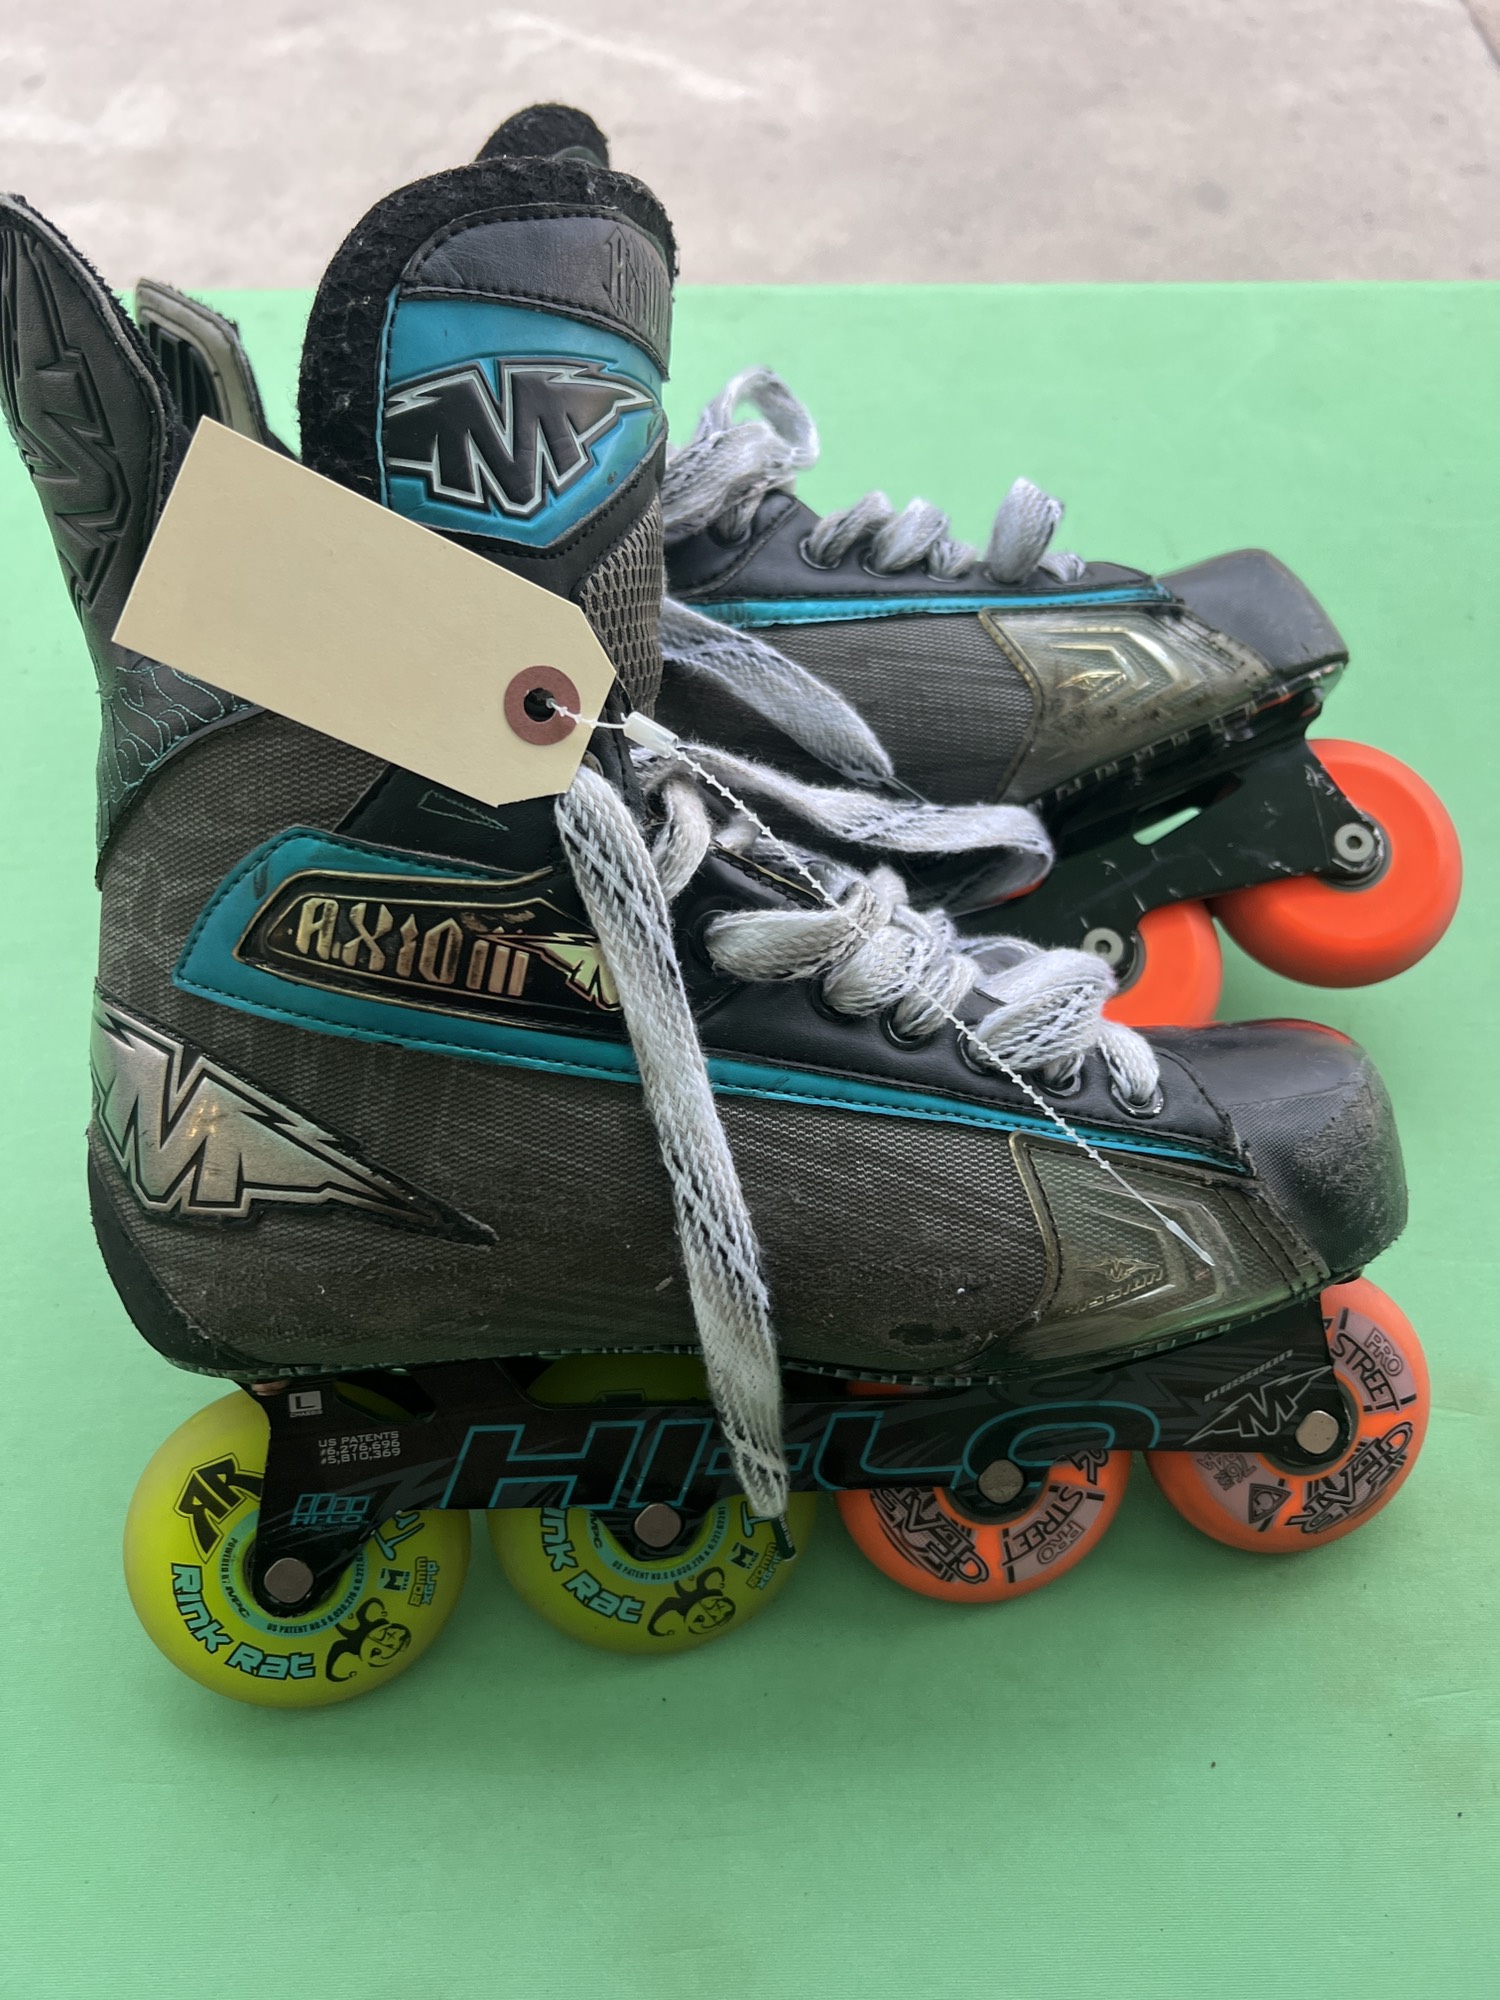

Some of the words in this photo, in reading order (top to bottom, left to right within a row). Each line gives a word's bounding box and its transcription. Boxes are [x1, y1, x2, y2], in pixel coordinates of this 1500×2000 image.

[1364, 1327, 1403, 1377] PRO
[1330, 1332, 1399, 1411] STREET
[318, 1438, 337, 1448] US
[341, 1431, 399, 1445] PATENTS
[320, 1440, 400, 1456] #6,276,696
[320, 1448, 401, 1465] #5,810,369
[1002, 1486, 1084, 1566] STREET
[1036, 1520, 1085, 1565] PRO
[266, 1623, 277, 1632] US
[279, 1625, 308, 1634] PATENT
